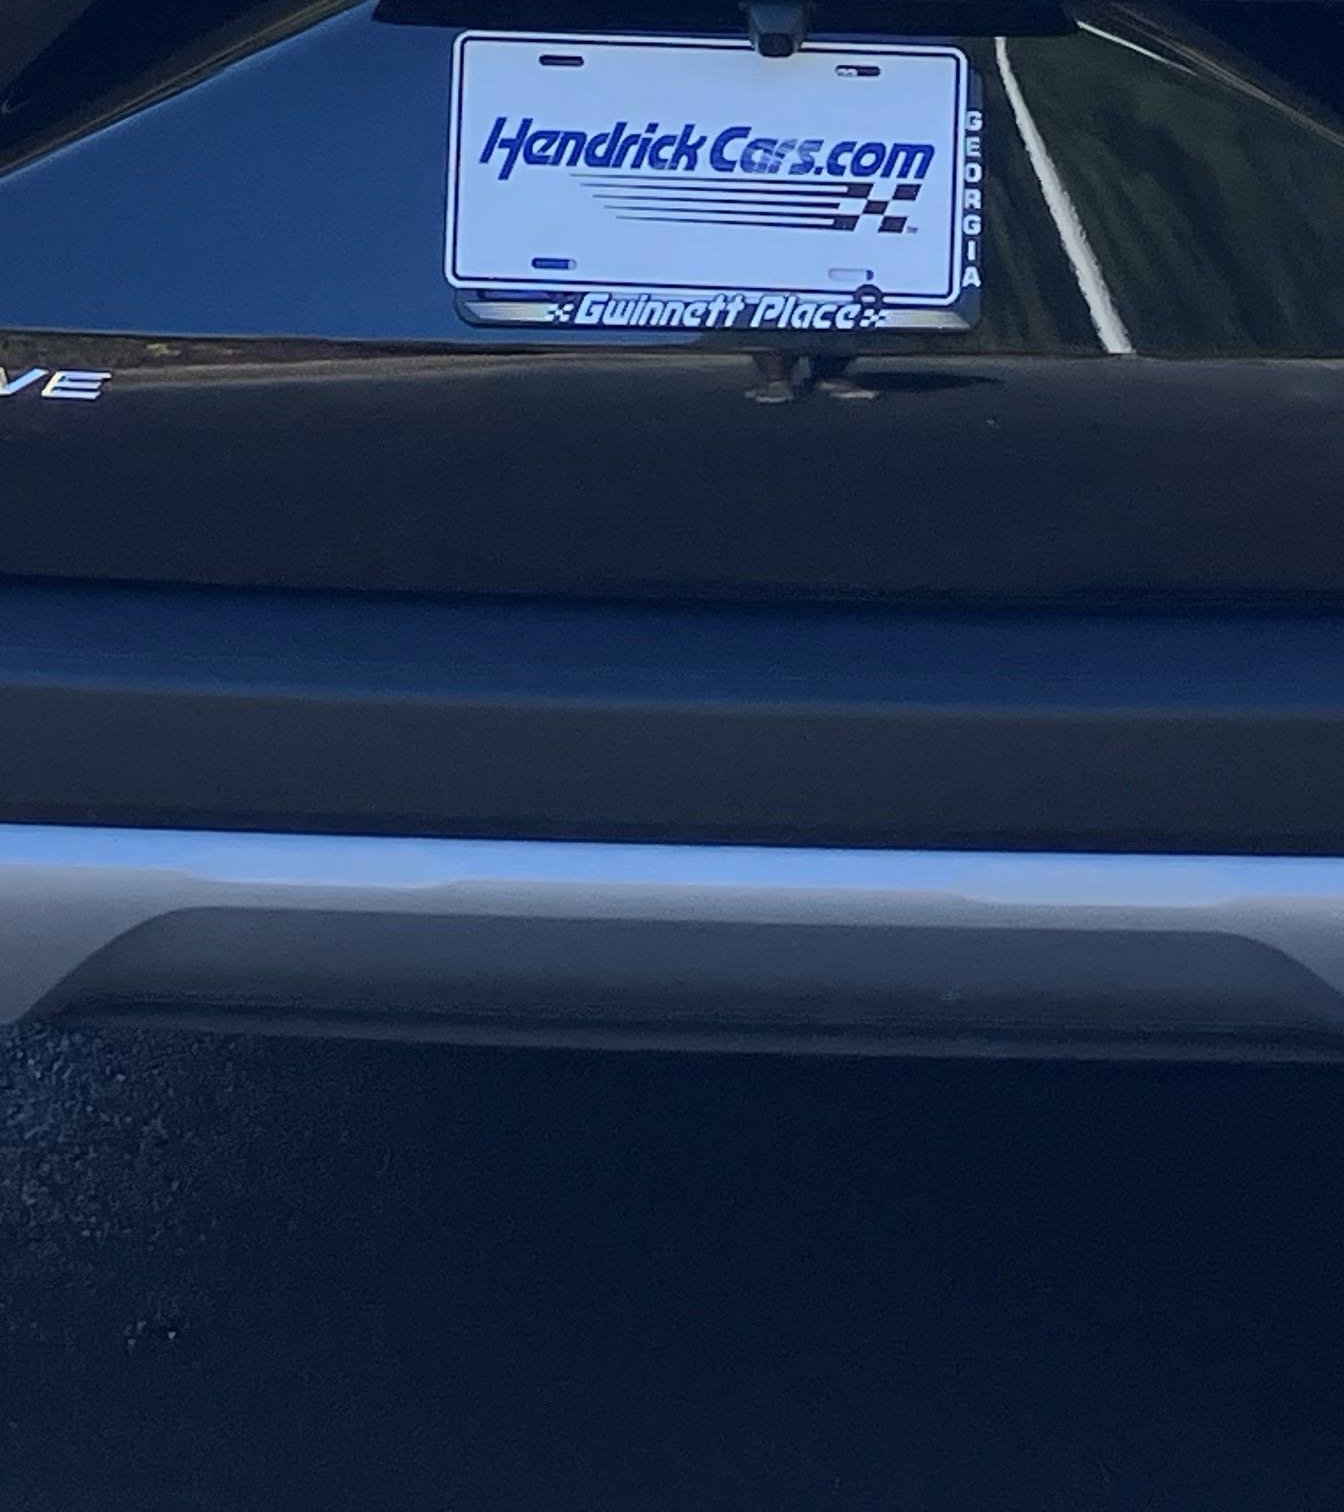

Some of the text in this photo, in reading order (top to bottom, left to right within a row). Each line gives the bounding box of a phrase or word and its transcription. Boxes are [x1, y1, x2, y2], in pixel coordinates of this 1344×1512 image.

[962, 110, 983, 288] GEORGIA
[574, 292, 861, 329] Gwinnett Place
